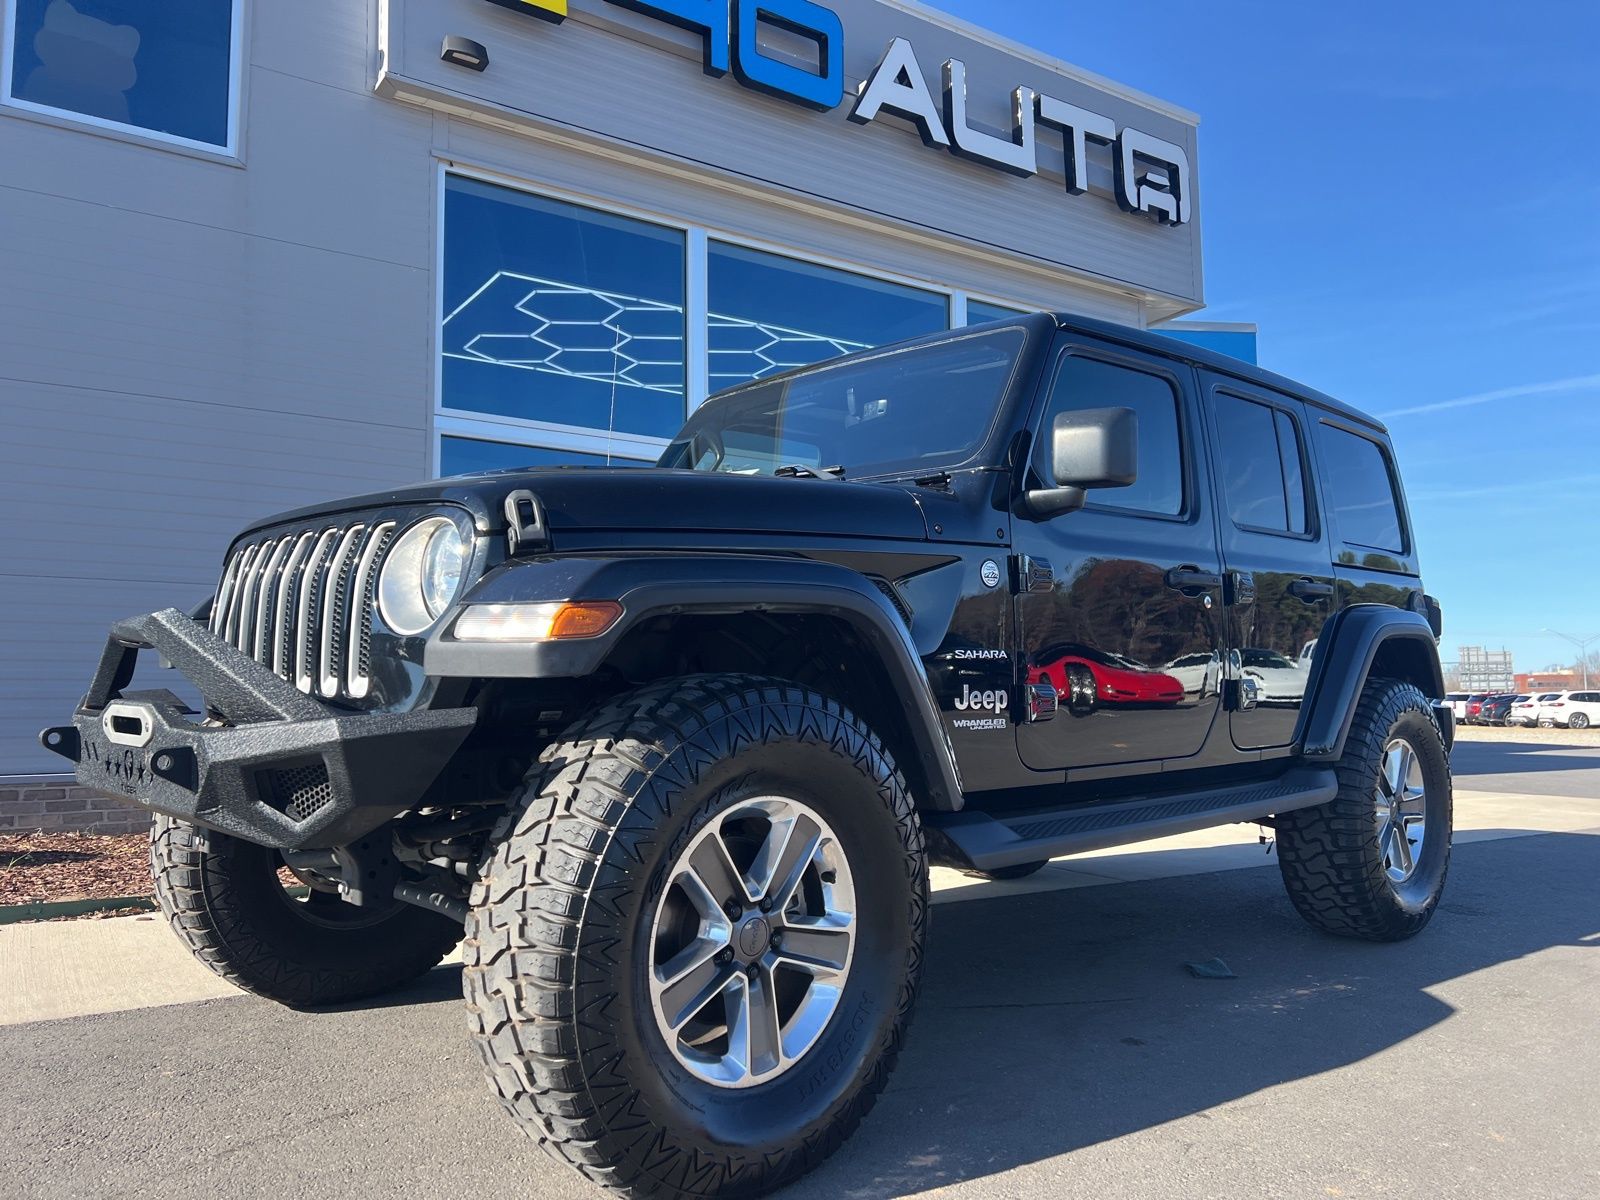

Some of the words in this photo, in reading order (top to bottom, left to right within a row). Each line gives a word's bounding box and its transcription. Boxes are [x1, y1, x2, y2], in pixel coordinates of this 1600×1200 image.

[954, 649, 1008, 659] SAHARA
[954, 683, 1008, 714] Jeep
[953, 719, 1006, 728] WRANGLER
